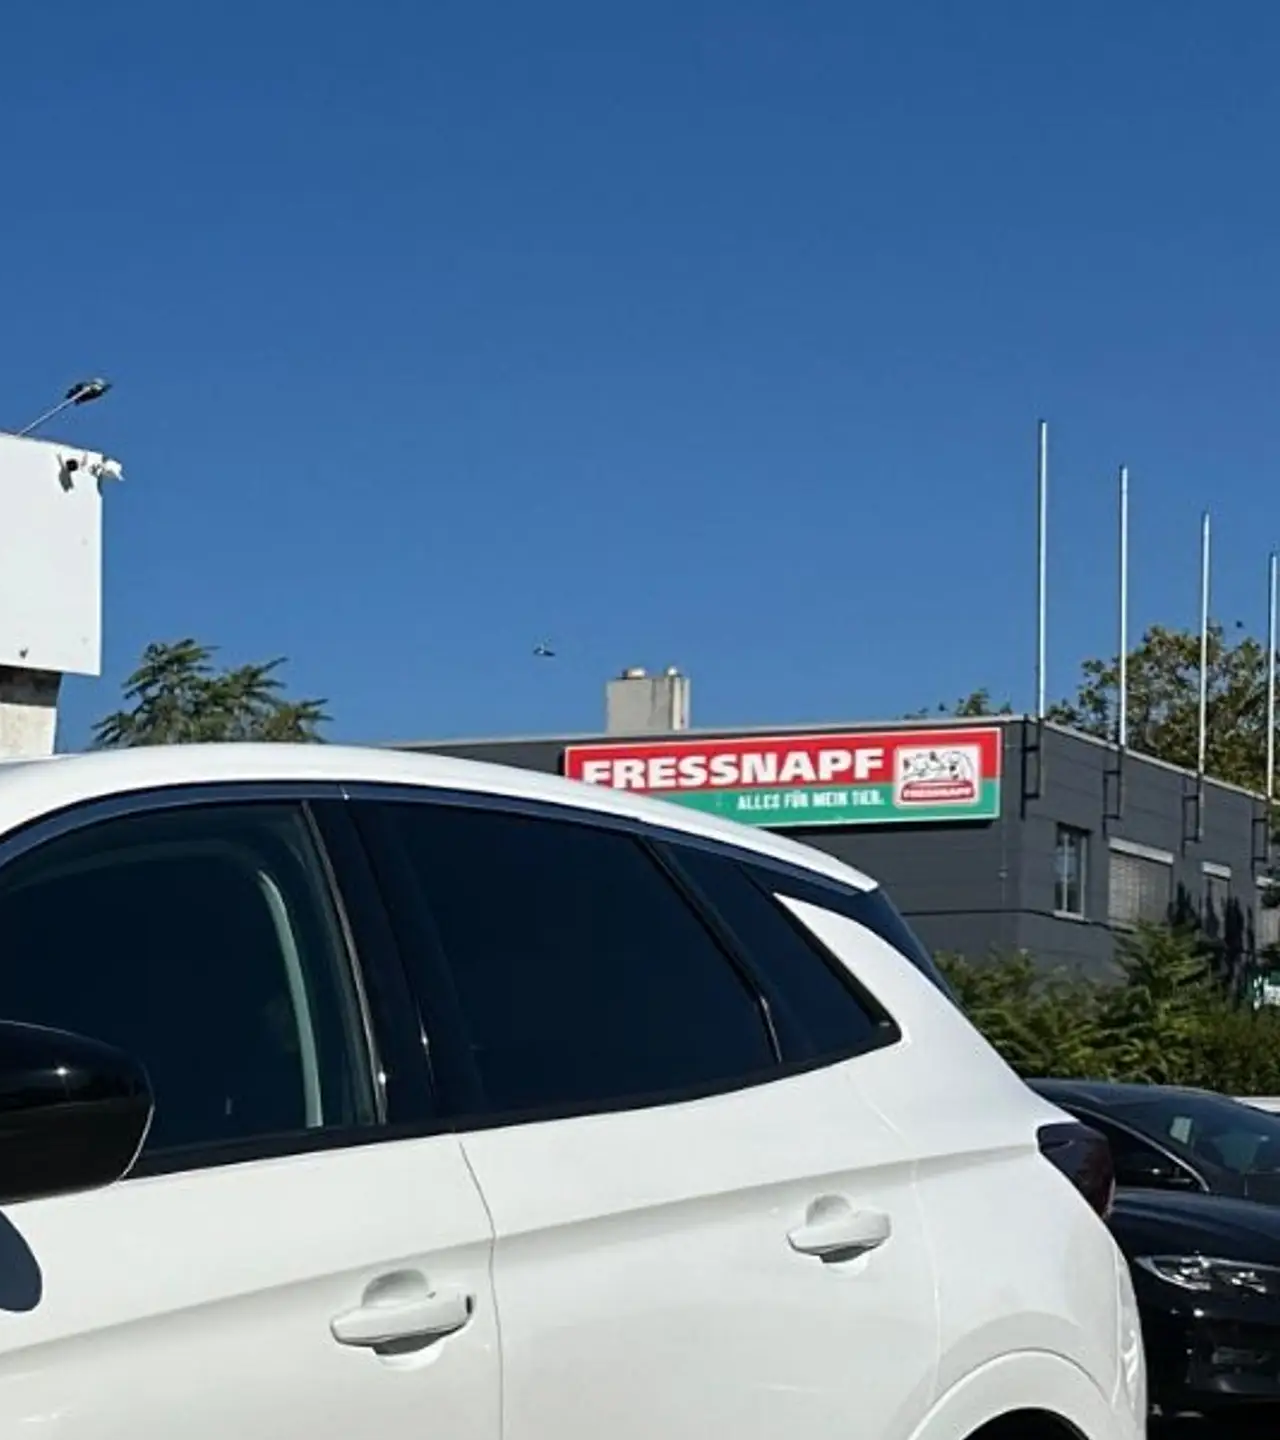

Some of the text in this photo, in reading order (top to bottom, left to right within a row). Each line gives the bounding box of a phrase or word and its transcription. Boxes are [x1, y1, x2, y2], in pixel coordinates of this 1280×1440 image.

[582, 748, 885, 790] FRESSNAPF
[737, 791, 780, 811] ALLES
[783, 788, 810, 809] FÜR
[813, 789, 848, 807] MEIN
